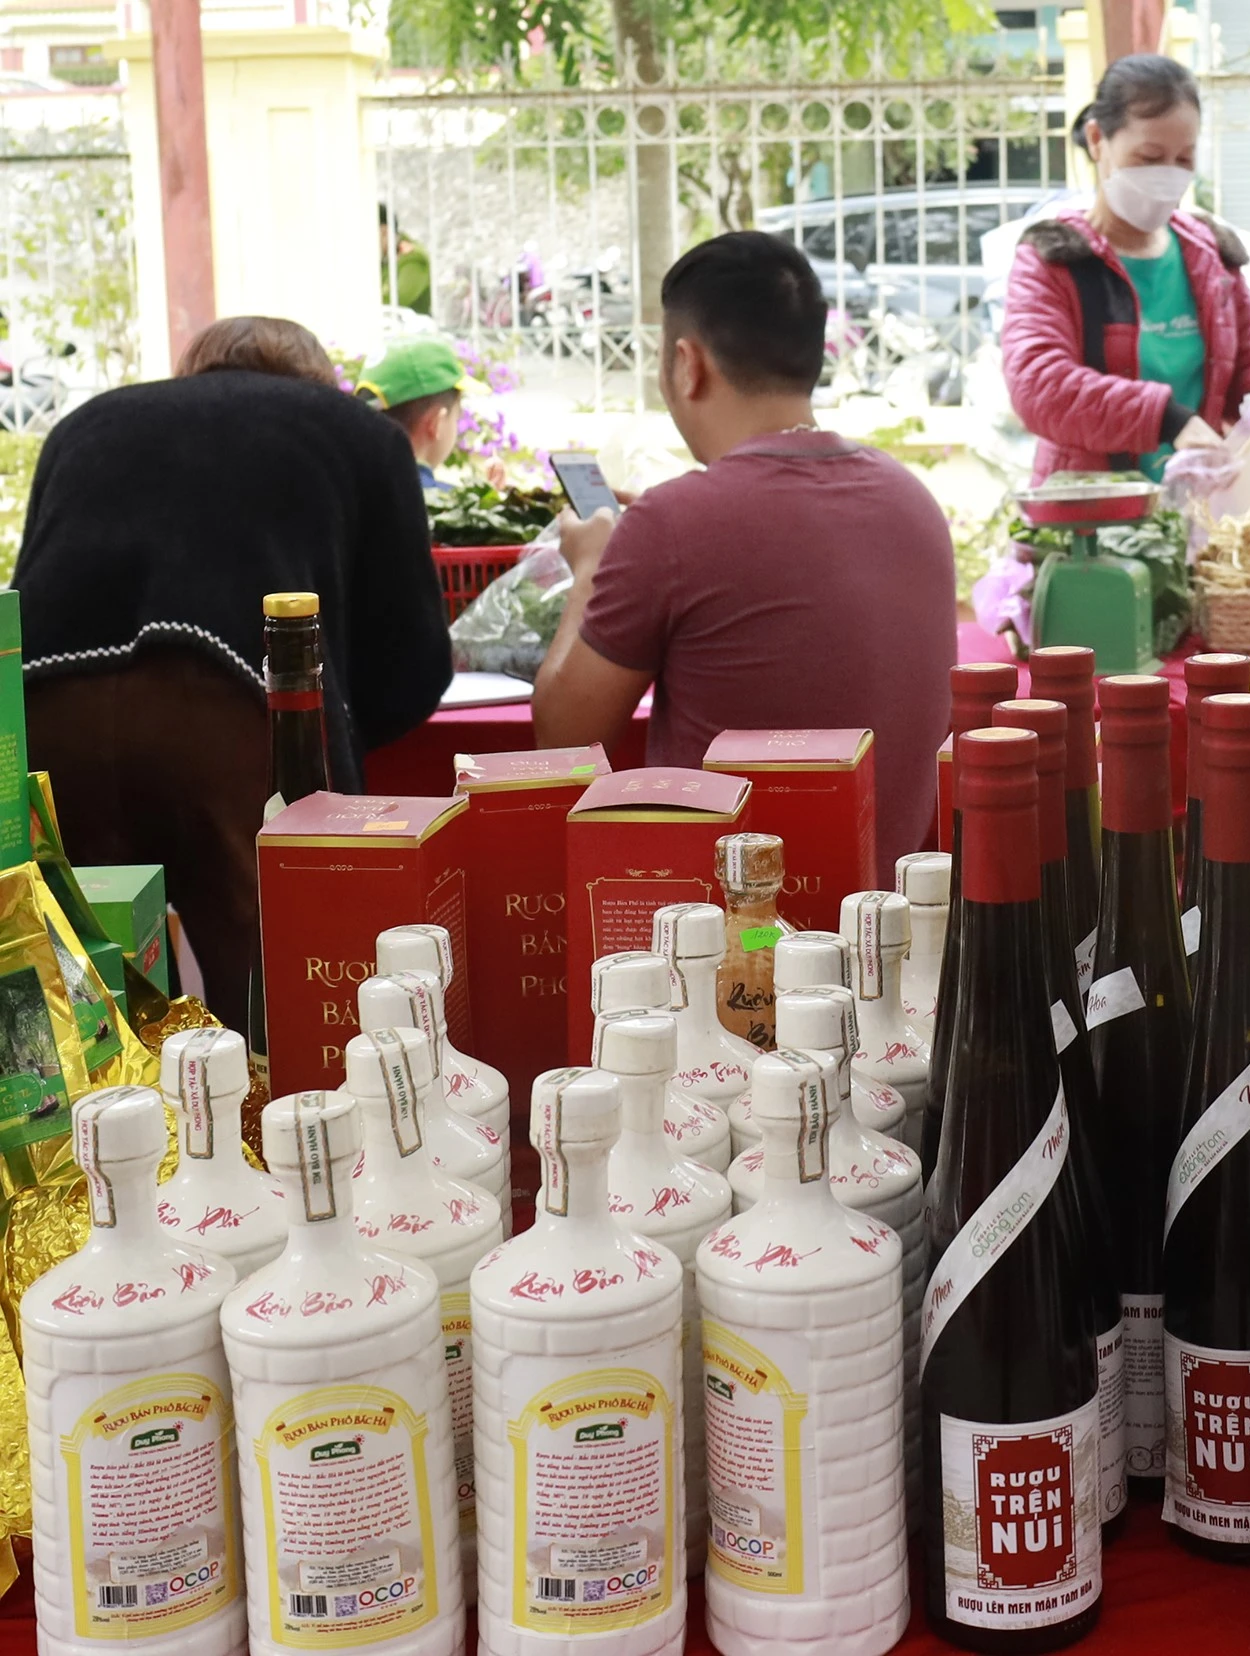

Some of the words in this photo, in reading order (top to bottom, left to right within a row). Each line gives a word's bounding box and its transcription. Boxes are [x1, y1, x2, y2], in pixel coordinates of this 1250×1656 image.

[505, 893, 565, 920] RƯỢ
[392, 1065, 405, 1093] HÀNH
[810, 1084, 818, 1108] HÀNH
[307, 1125, 318, 1152] HÀNH
[310, 1153, 321, 1171] BẢO
[990, 1466, 1060, 1487] RƯỢU
[991, 1488, 1061, 1515] TRÊN
[1174, 1500, 1191, 1518] RƯỢU
[1192, 1509, 1207, 1524] LÊN
[1209, 1514, 1230, 1528] MEN
[727, 1531, 774, 1555] OCOP
[169, 1561, 219, 1592] OCOP
[607, 1565, 657, 1592] OCOP
[358, 1577, 415, 1606] OCOP
[958, 1596, 983, 1613] RƯỢU
[986, 1597, 1004, 1614] LÊN
[1008, 1598, 1031, 1614] MEN
[1035, 1595, 1057, 1613] MẬN
[1060, 1590, 1079, 1607] TAM
[1080, 1579, 1093, 1598] HOA
